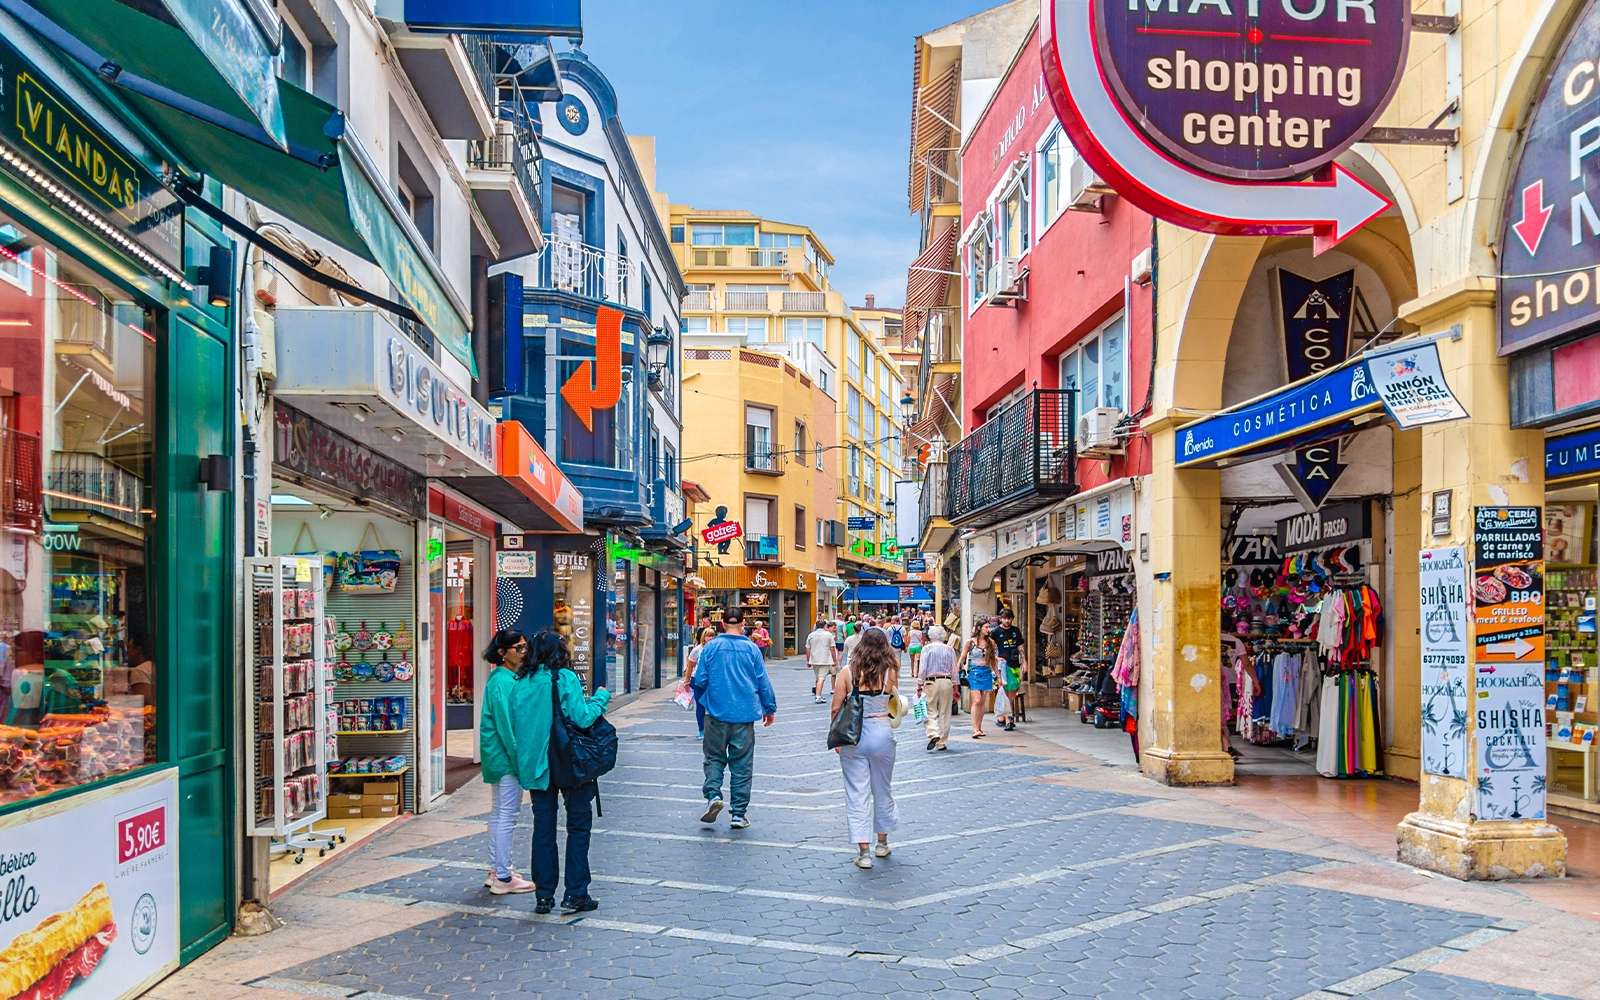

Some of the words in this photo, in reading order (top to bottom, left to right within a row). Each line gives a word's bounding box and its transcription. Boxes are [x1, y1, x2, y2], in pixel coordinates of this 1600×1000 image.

[1147, 50, 1361, 106] shopping
[1183, 109, 1331, 149] center
[25, 90, 135, 209] VIANDAS
[1510, 267, 1600, 327] sho
[1385, 375, 1434, 393] UNIÓN
[1233, 390, 1332, 437] COSMÉTICA
[706, 523, 738, 542] gofres
[1286, 512, 1320, 547] MODA
[1323, 518, 1347, 538] PASEO
[1476, 533, 1541, 542] PARRILLADAS
[1483, 542, 1495, 550] de
[1525, 543, 1531, 551] y
[1483, 551, 1495, 559] de
[1497, 550, 1534, 559] marisco
[555, 554, 588, 566] OUTLET
[1421, 585, 1463, 605] SHISHA
[1511, 591, 1541, 605] BBQ
[1426, 610, 1459, 621] COCKTAIL
[1476, 616, 1498, 624] meat
[1508, 615, 1543, 625] seafood
[1491, 608, 1527, 616] GRILLED
[1478, 634, 1496, 643] Plaza
[1497, 630, 1518, 642] Mayor
[1478, 709, 1542, 729] SHISHA
[1486, 735, 1536, 747] COCKTAIL
[125, 821, 160, 857] 5,90€
